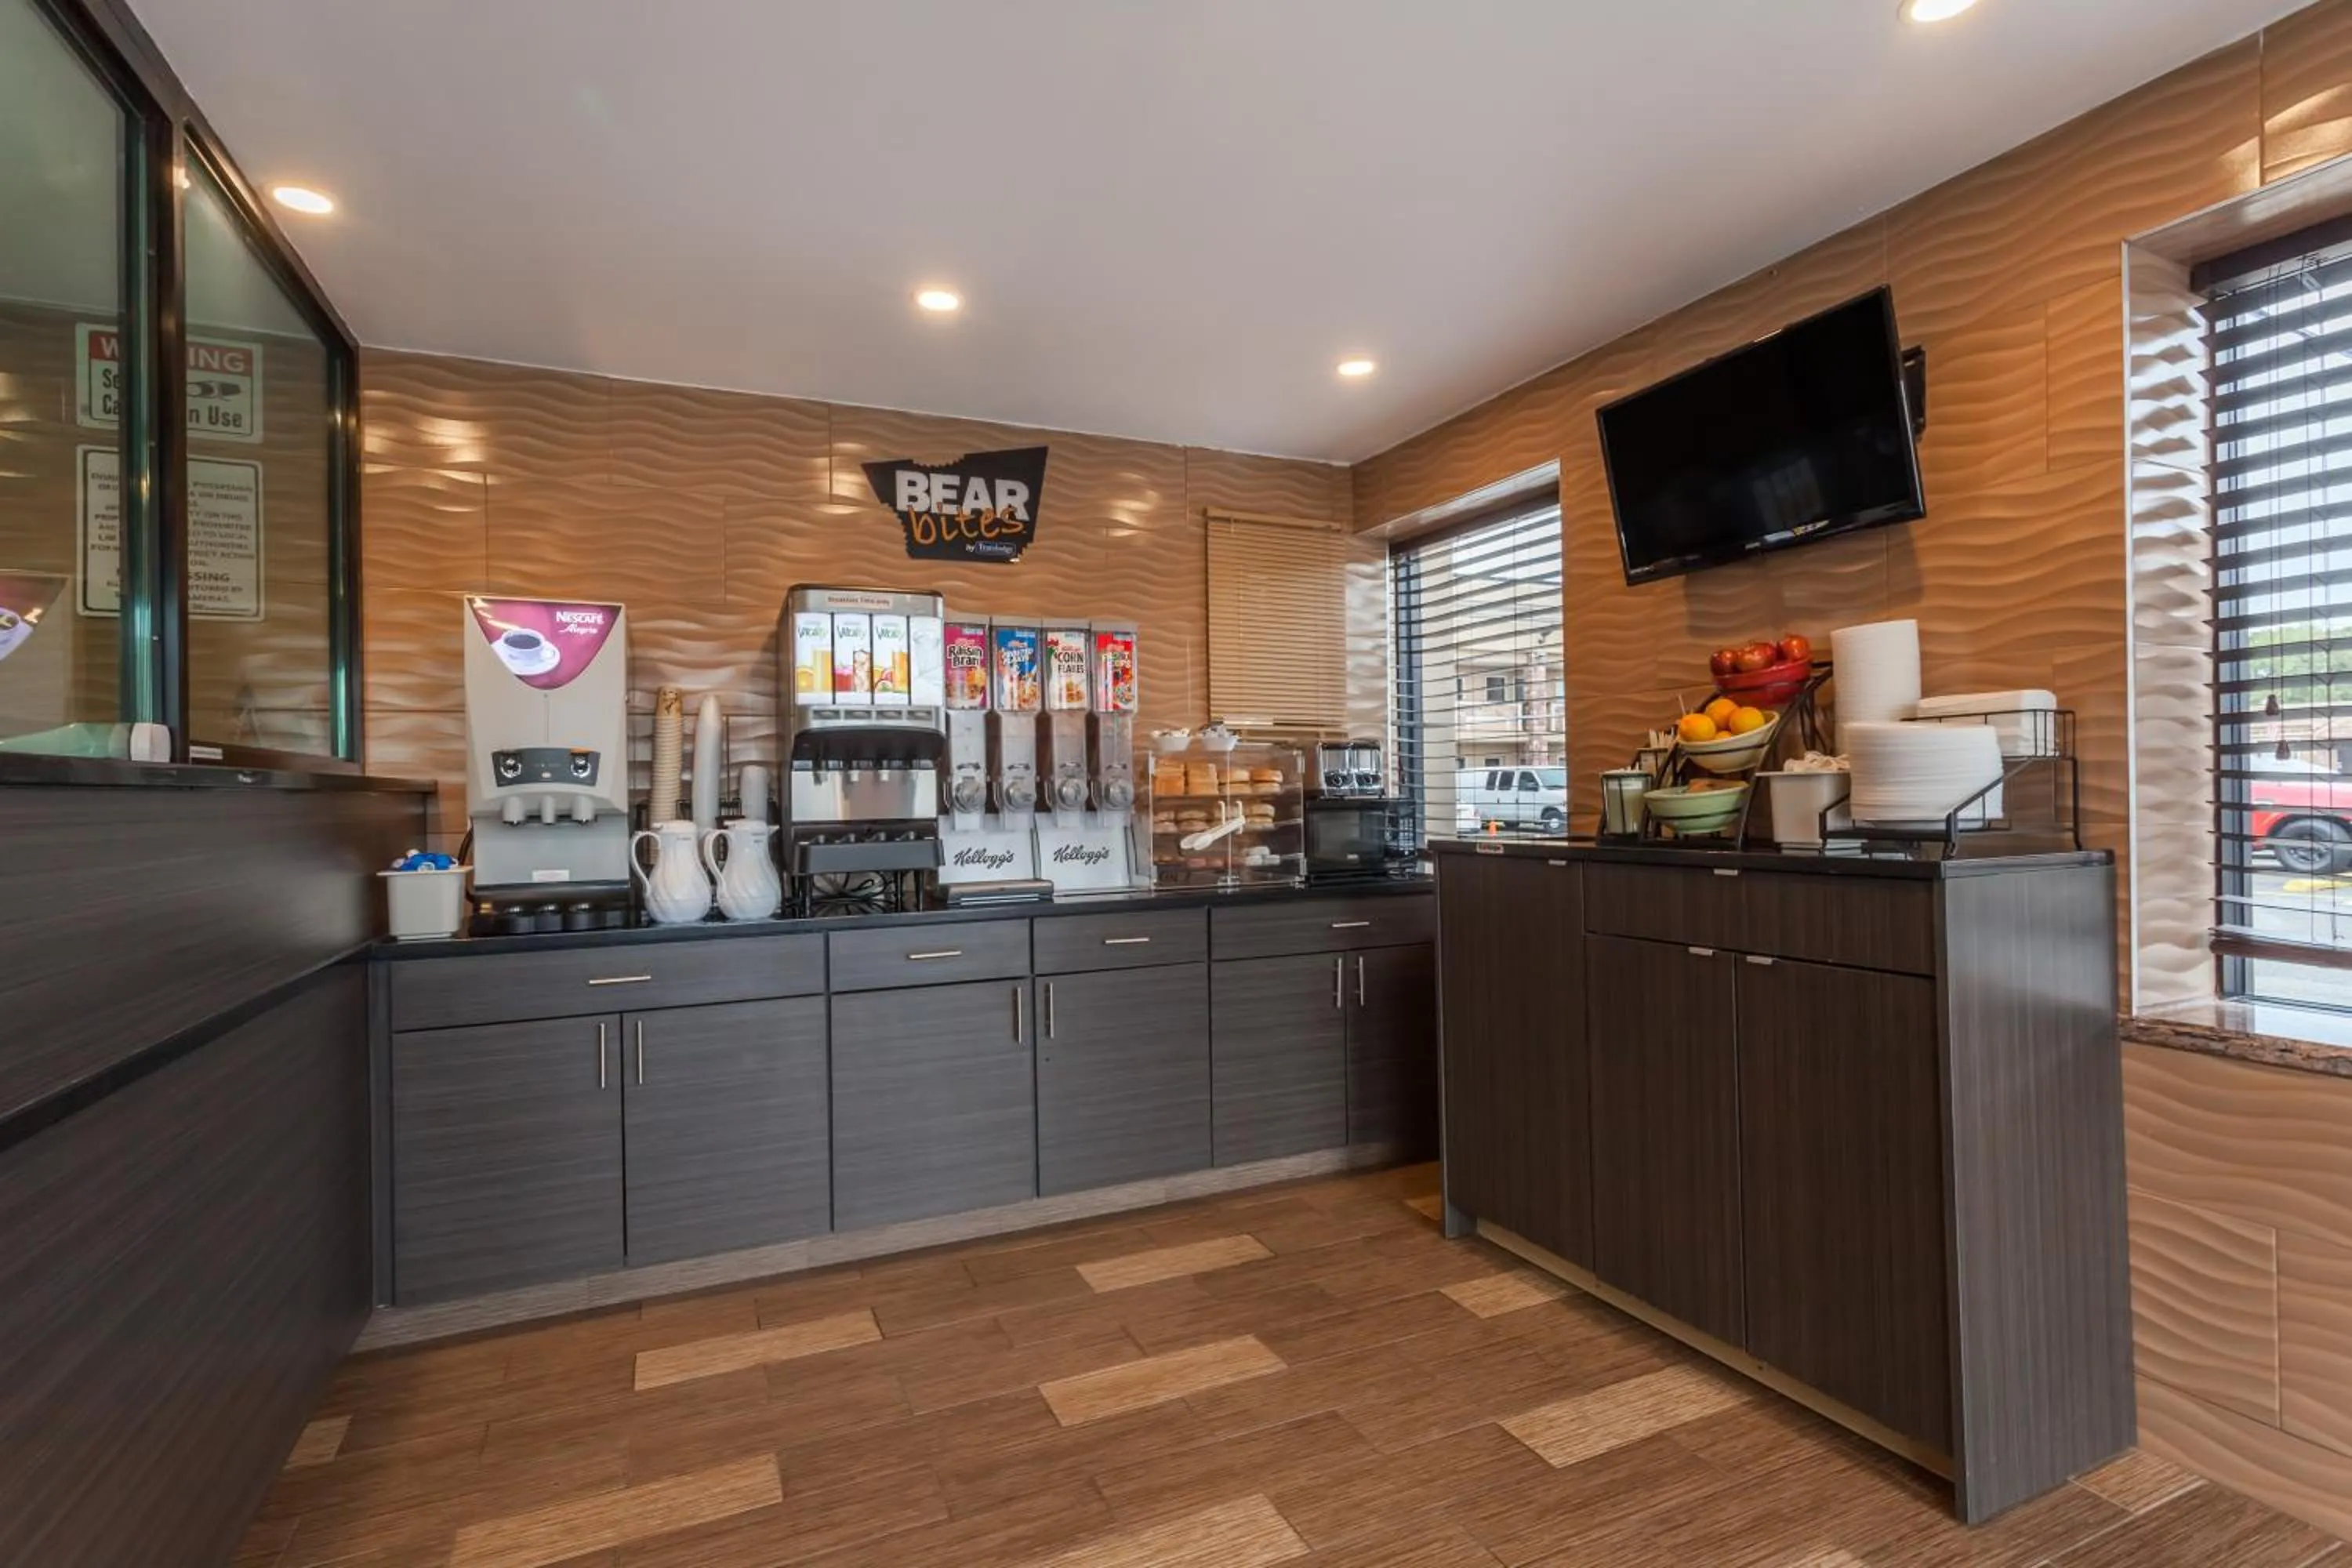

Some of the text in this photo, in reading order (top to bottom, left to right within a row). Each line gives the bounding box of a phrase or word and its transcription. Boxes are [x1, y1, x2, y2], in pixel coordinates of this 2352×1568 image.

[208, 405, 242, 427] Use
[895, 470, 1029, 521] BEAR
[907, 502, 1024, 544] bites
[949, 645, 982, 658] Raisin
[953, 656, 979, 667] Bran
[1058, 652, 1084, 663] CORN
[1058, 663, 1084, 674] FLAKES
[953, 848, 1014, 869] Kellogg's
[1054, 844, 1109, 866] Kellogg's
